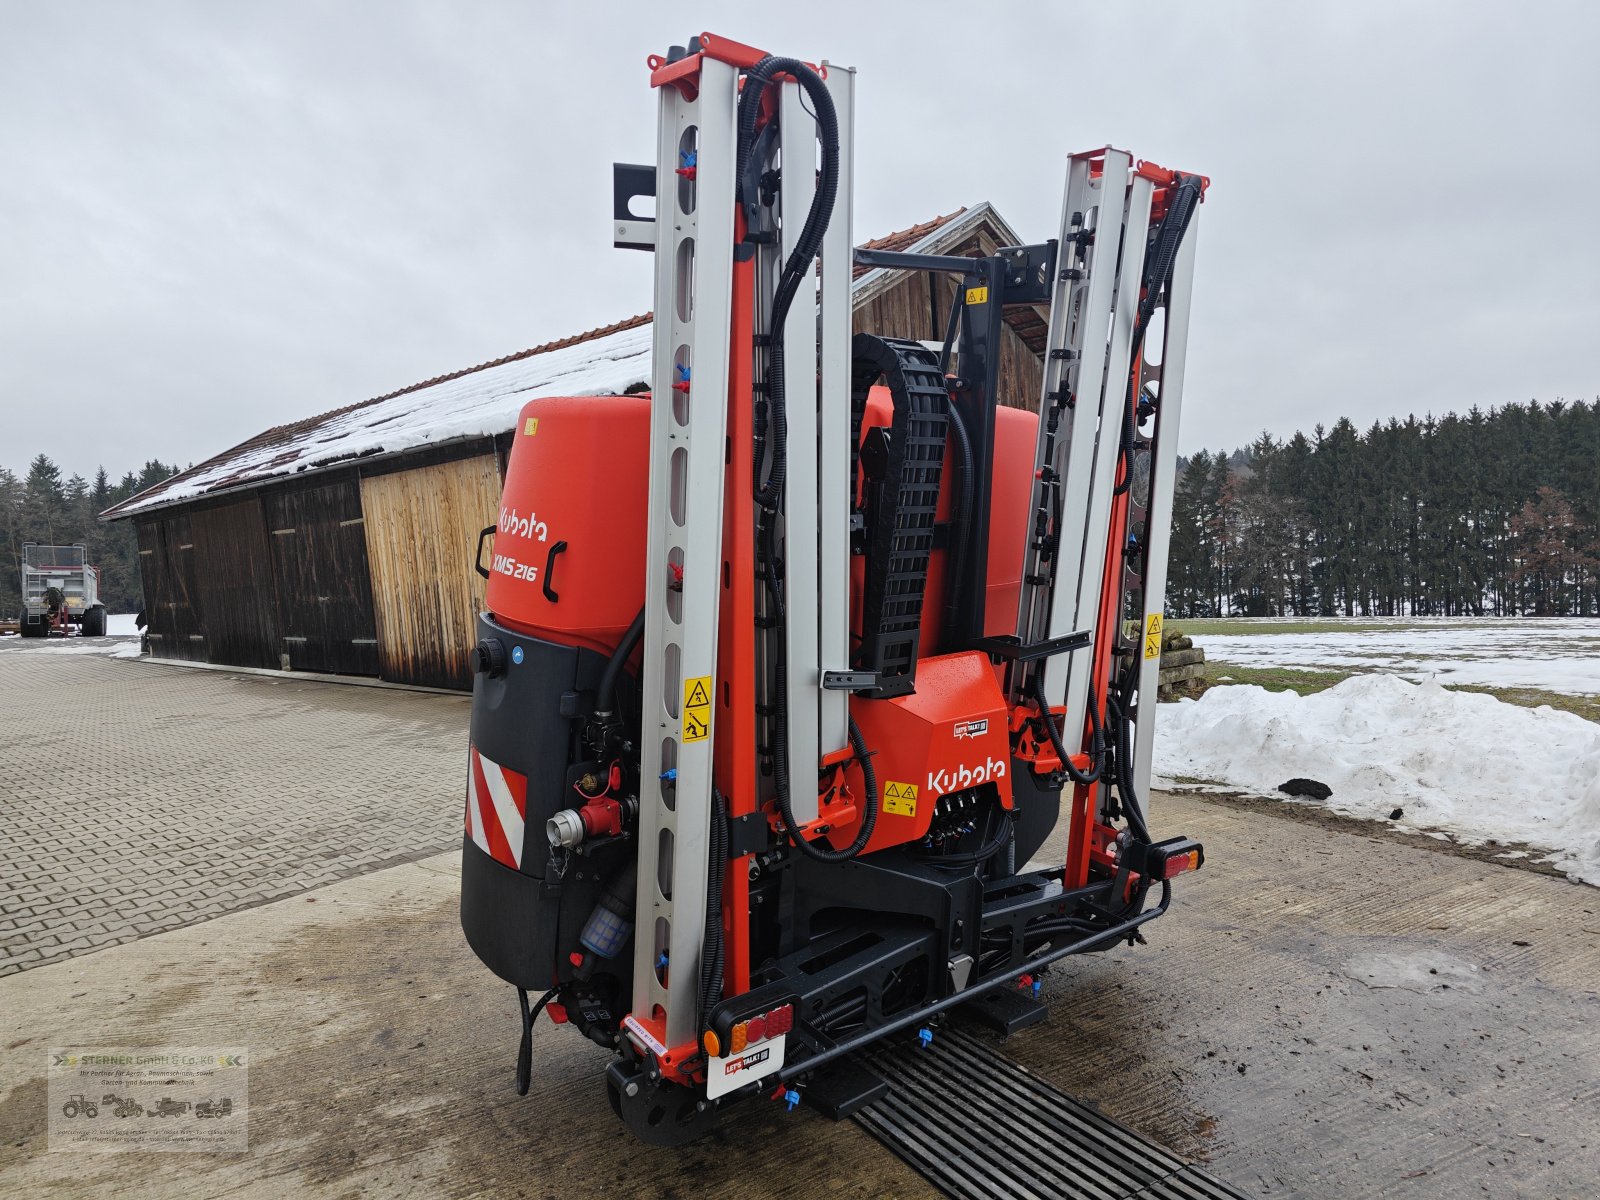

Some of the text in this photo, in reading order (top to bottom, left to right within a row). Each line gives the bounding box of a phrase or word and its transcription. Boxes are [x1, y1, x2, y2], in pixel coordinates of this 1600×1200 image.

[499, 506, 548, 542] Kubota
[492, 554, 538, 582] XMS 216
[927, 756, 1006, 794] Kubota
[726, 1053, 760, 1073] LET'S TALK!
